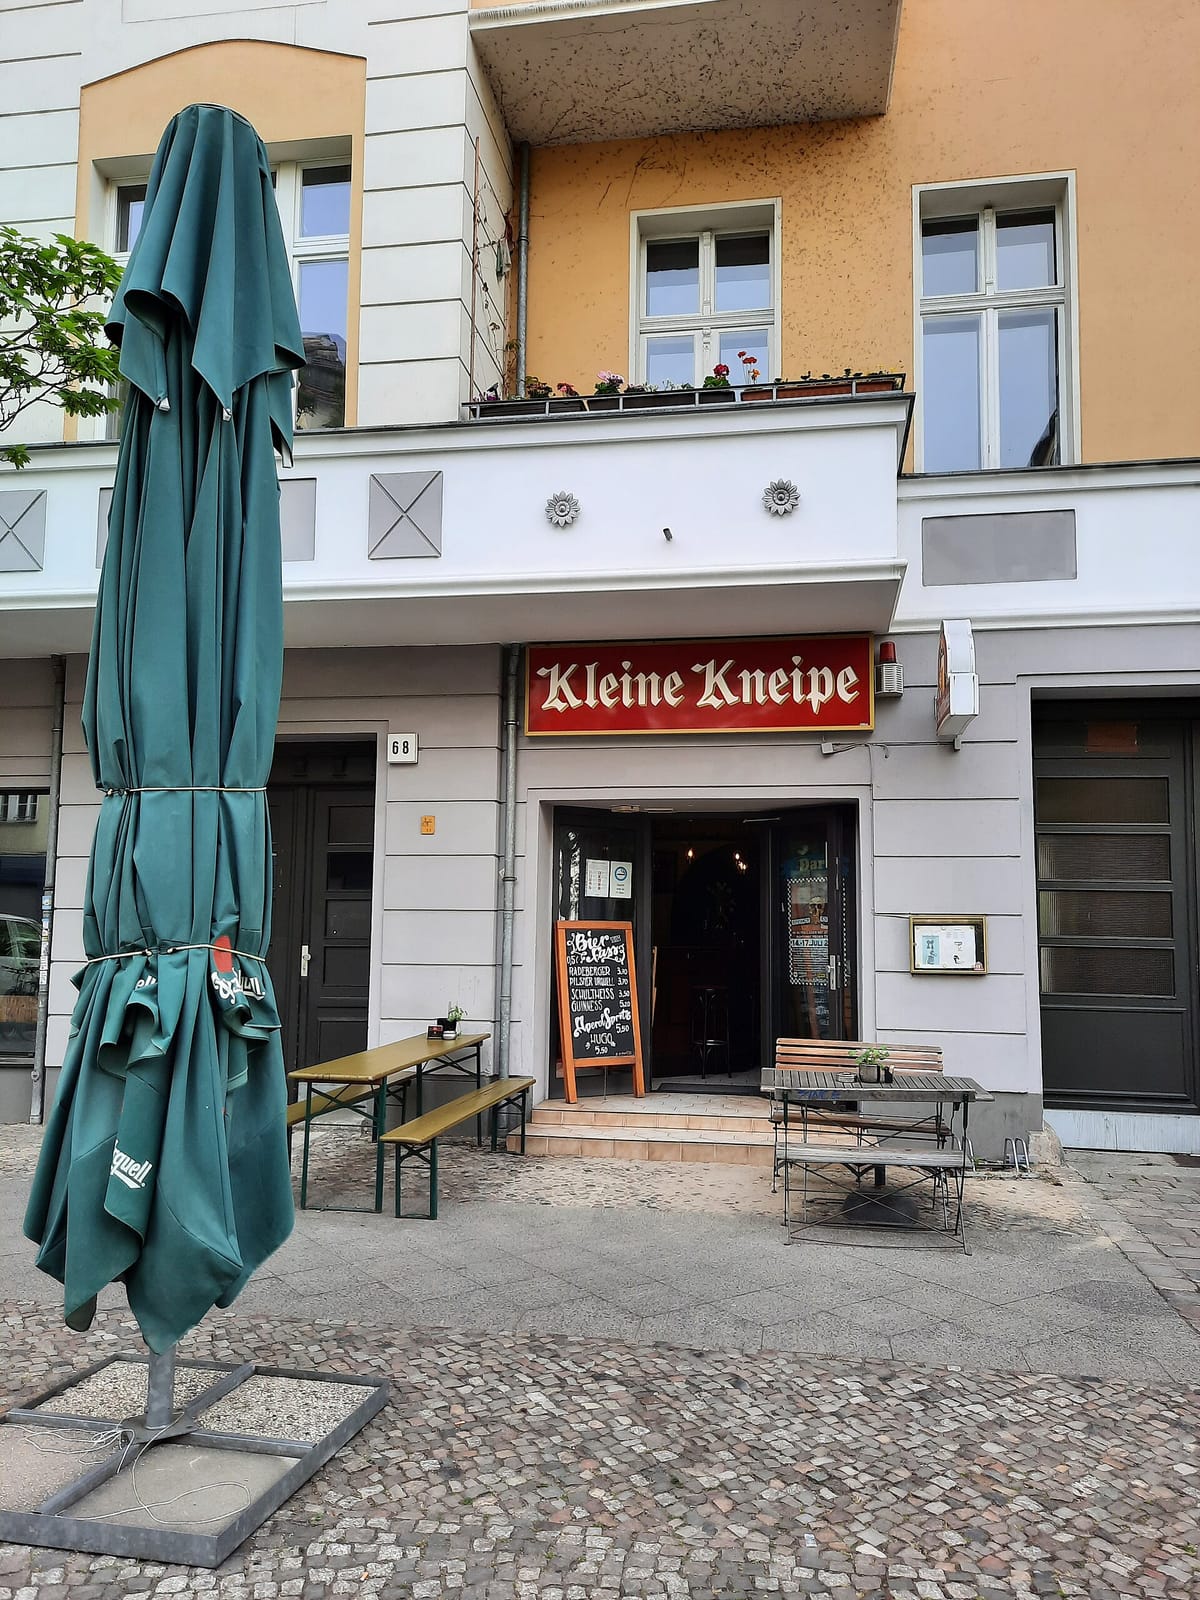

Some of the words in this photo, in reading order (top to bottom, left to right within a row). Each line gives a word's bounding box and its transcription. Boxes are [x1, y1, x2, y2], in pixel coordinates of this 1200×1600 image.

[536, 660, 684, 714] Kleine
[691, 655, 860, 715] Kneipe
[392, 741, 409, 754] 68
[575, 930, 609, 951] Bier
[568, 966, 611, 976] RADEBERGER
[571, 988, 615, 1000] SCHULTHEISS
[571, 1000, 603, 1012] GUINNESS
[590, 1032, 613, 1044] HUGO
